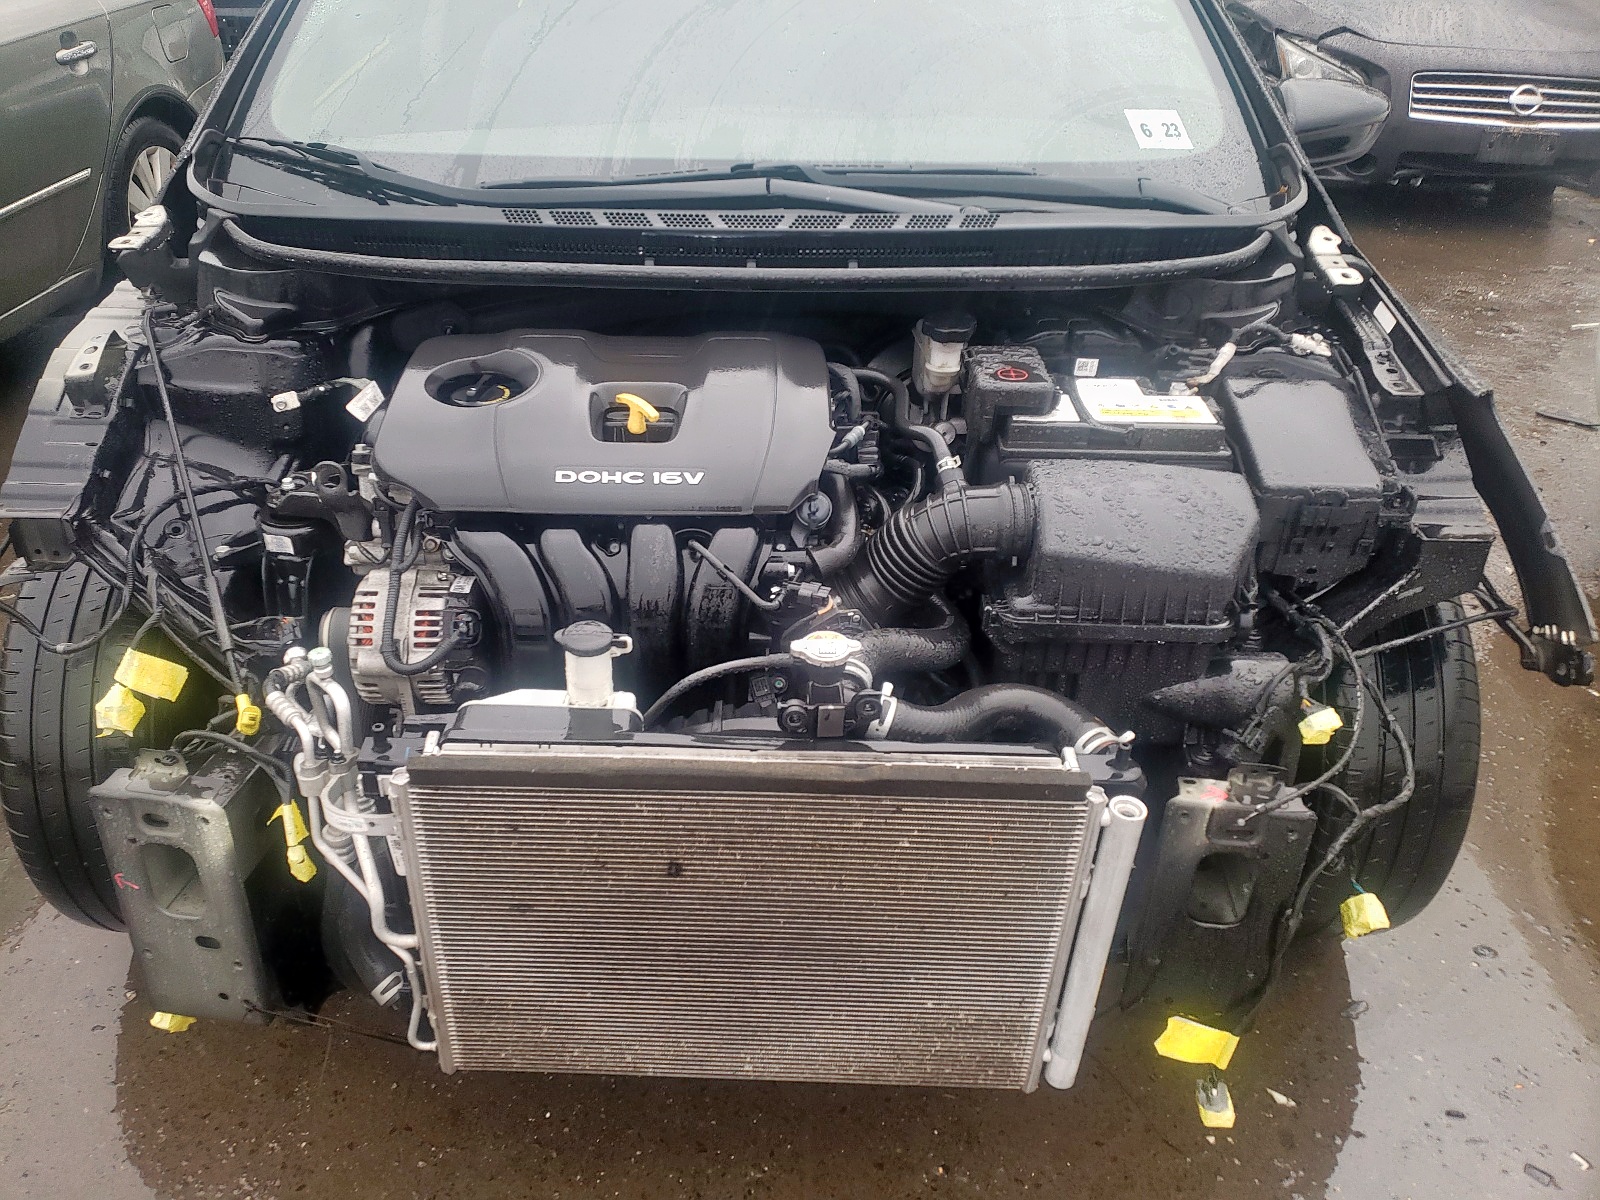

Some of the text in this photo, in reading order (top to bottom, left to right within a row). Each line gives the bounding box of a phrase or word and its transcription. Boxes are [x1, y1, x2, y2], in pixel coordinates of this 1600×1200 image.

[1140, 122, 1182, 138] 6 23
[554, 470, 706, 486] DOHC 16V
